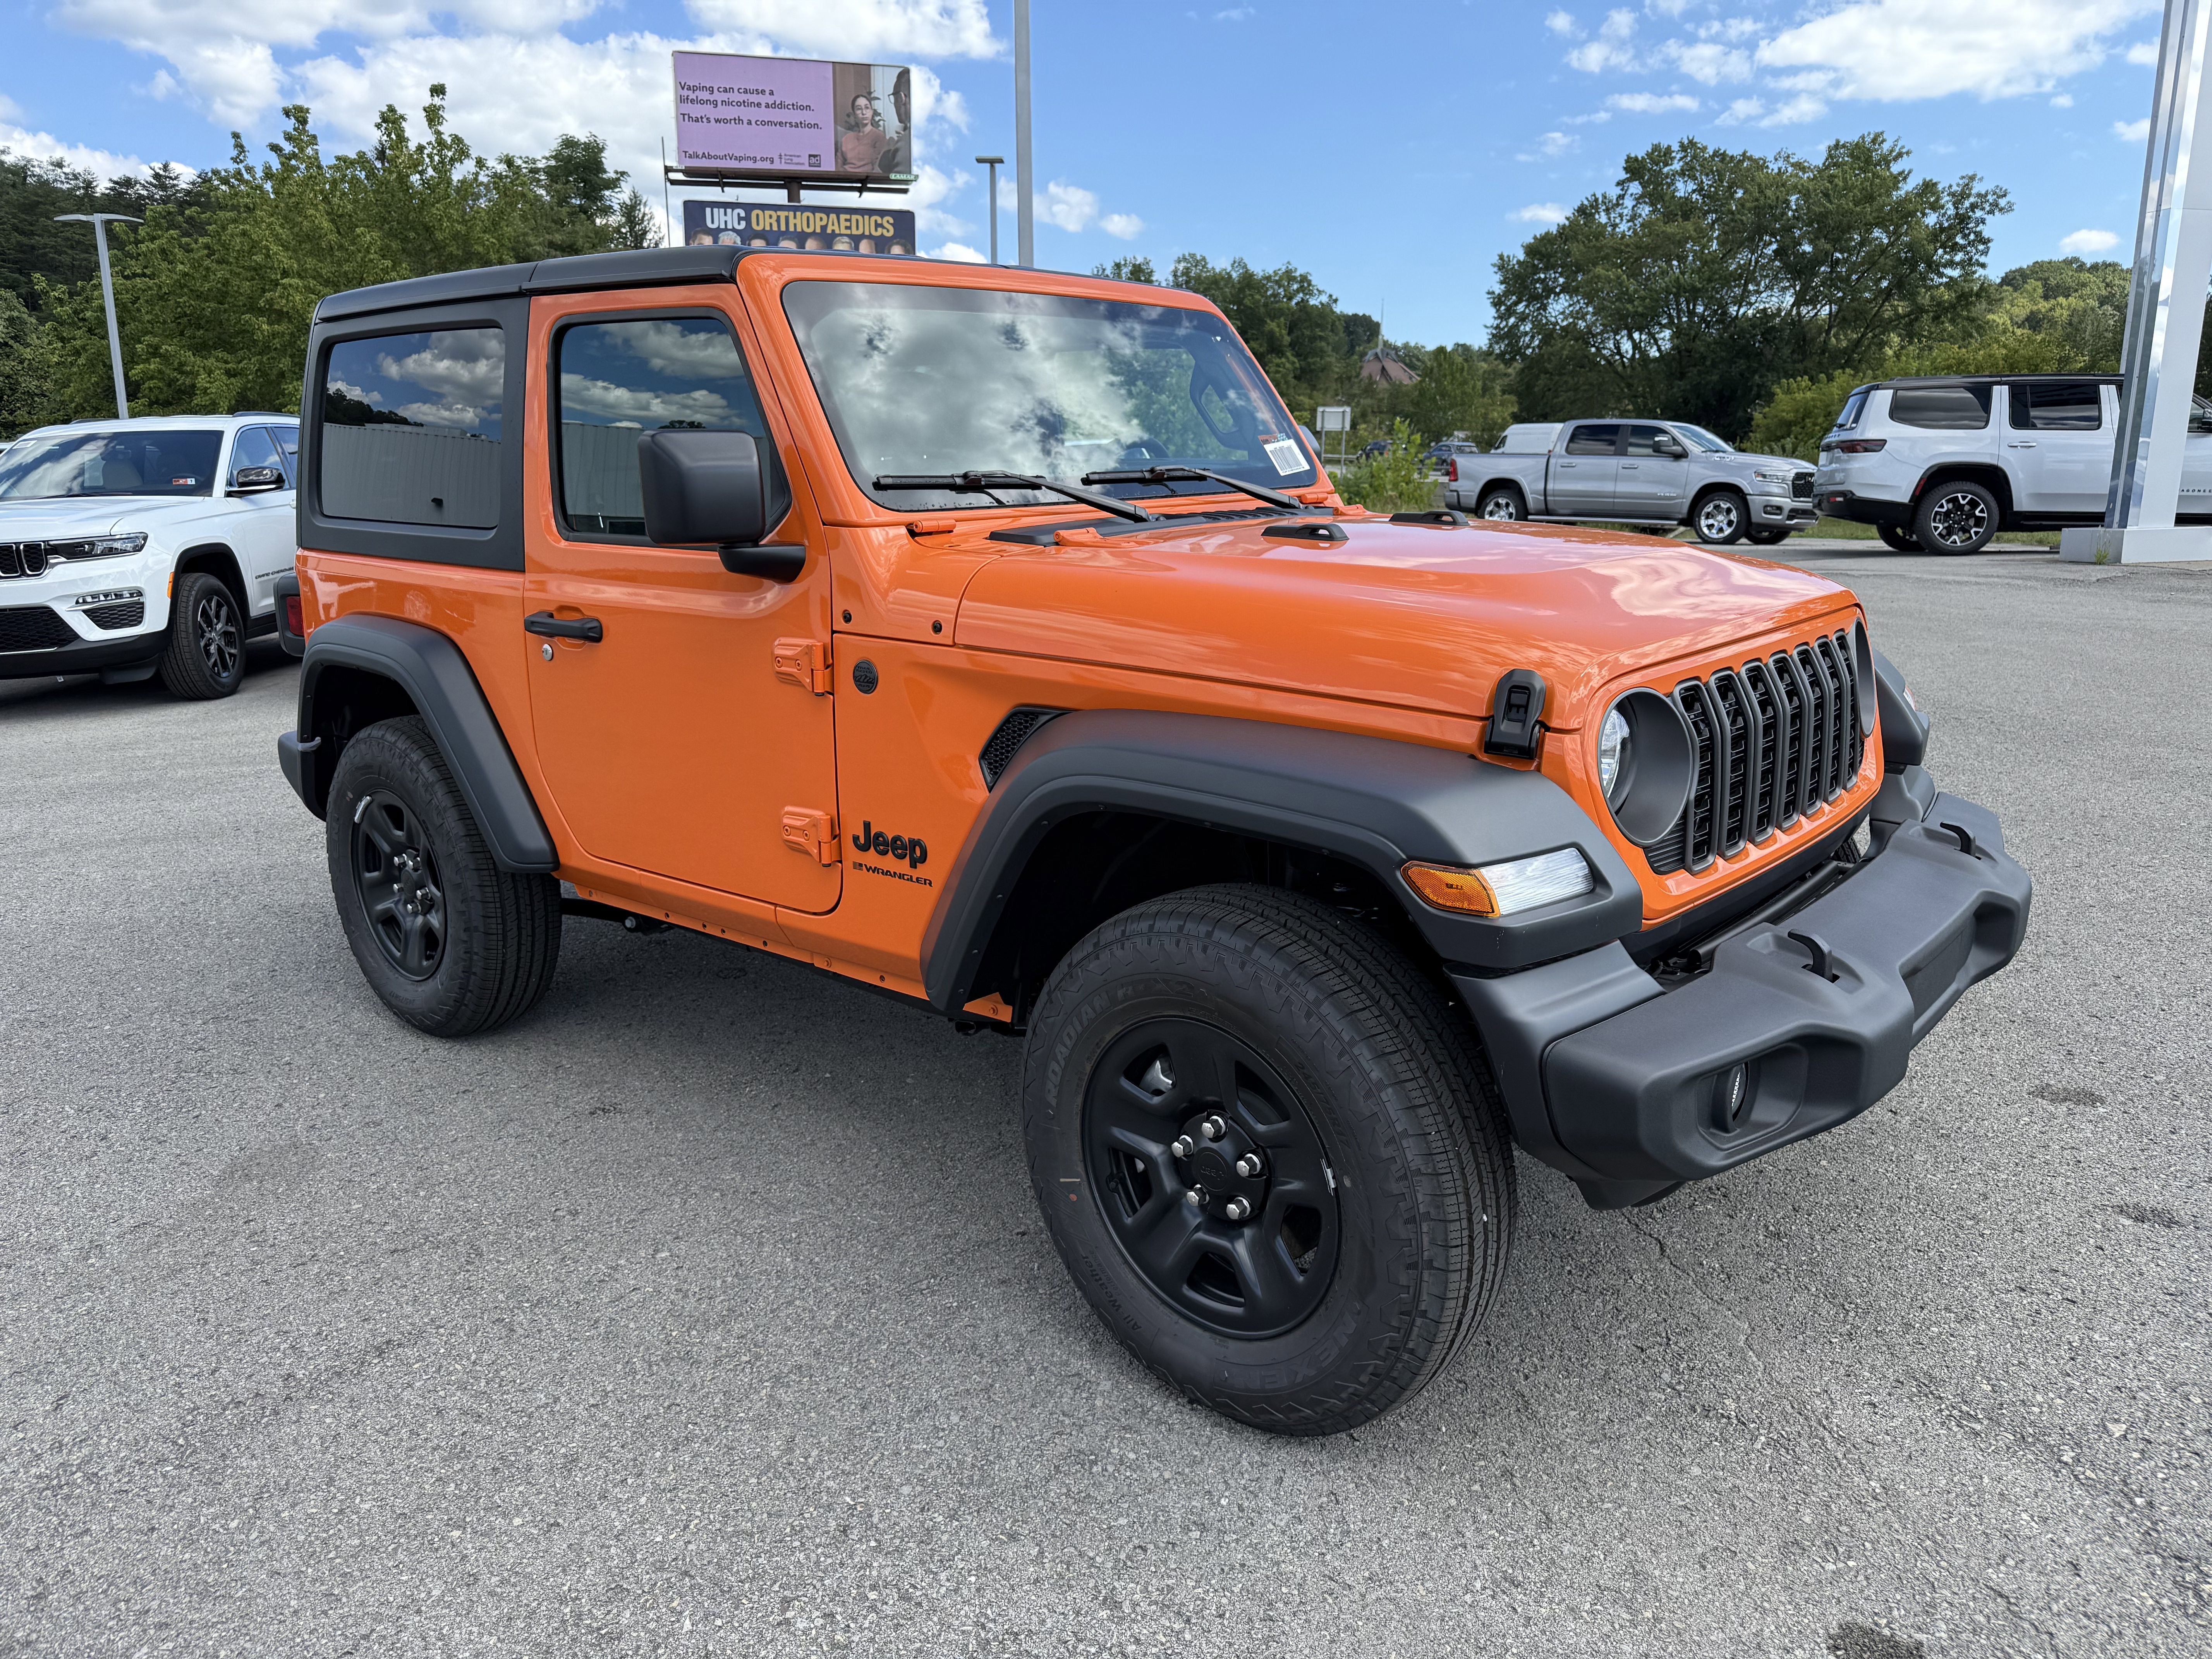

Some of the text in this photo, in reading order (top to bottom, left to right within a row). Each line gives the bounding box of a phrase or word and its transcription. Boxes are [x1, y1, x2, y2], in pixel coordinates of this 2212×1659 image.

[679, 82, 714, 94] Vaping
[737, 87, 766, 95] cause
[680, 94, 814, 112] lifelong nicotine addiction.
[680, 113, 711, 124] That's
[714, 116, 744, 125] worth
[755, 118, 822, 130] conversation.
[683, 151, 774, 164] TalkAboutVaping.org
[705, 207, 894, 237] UHC ORTHOPAEDICS
[852, 820, 927, 869] Jeep
[864, 864, 933, 887] WRANGLER
[1044, 991, 1112, 1108] ROADIAN
[1294, 1061, 1352, 1149] 245/75R17
[1080, 1254, 1142, 1331] All-Weather
[1233, 1311, 1357, 1389] NEXEN
